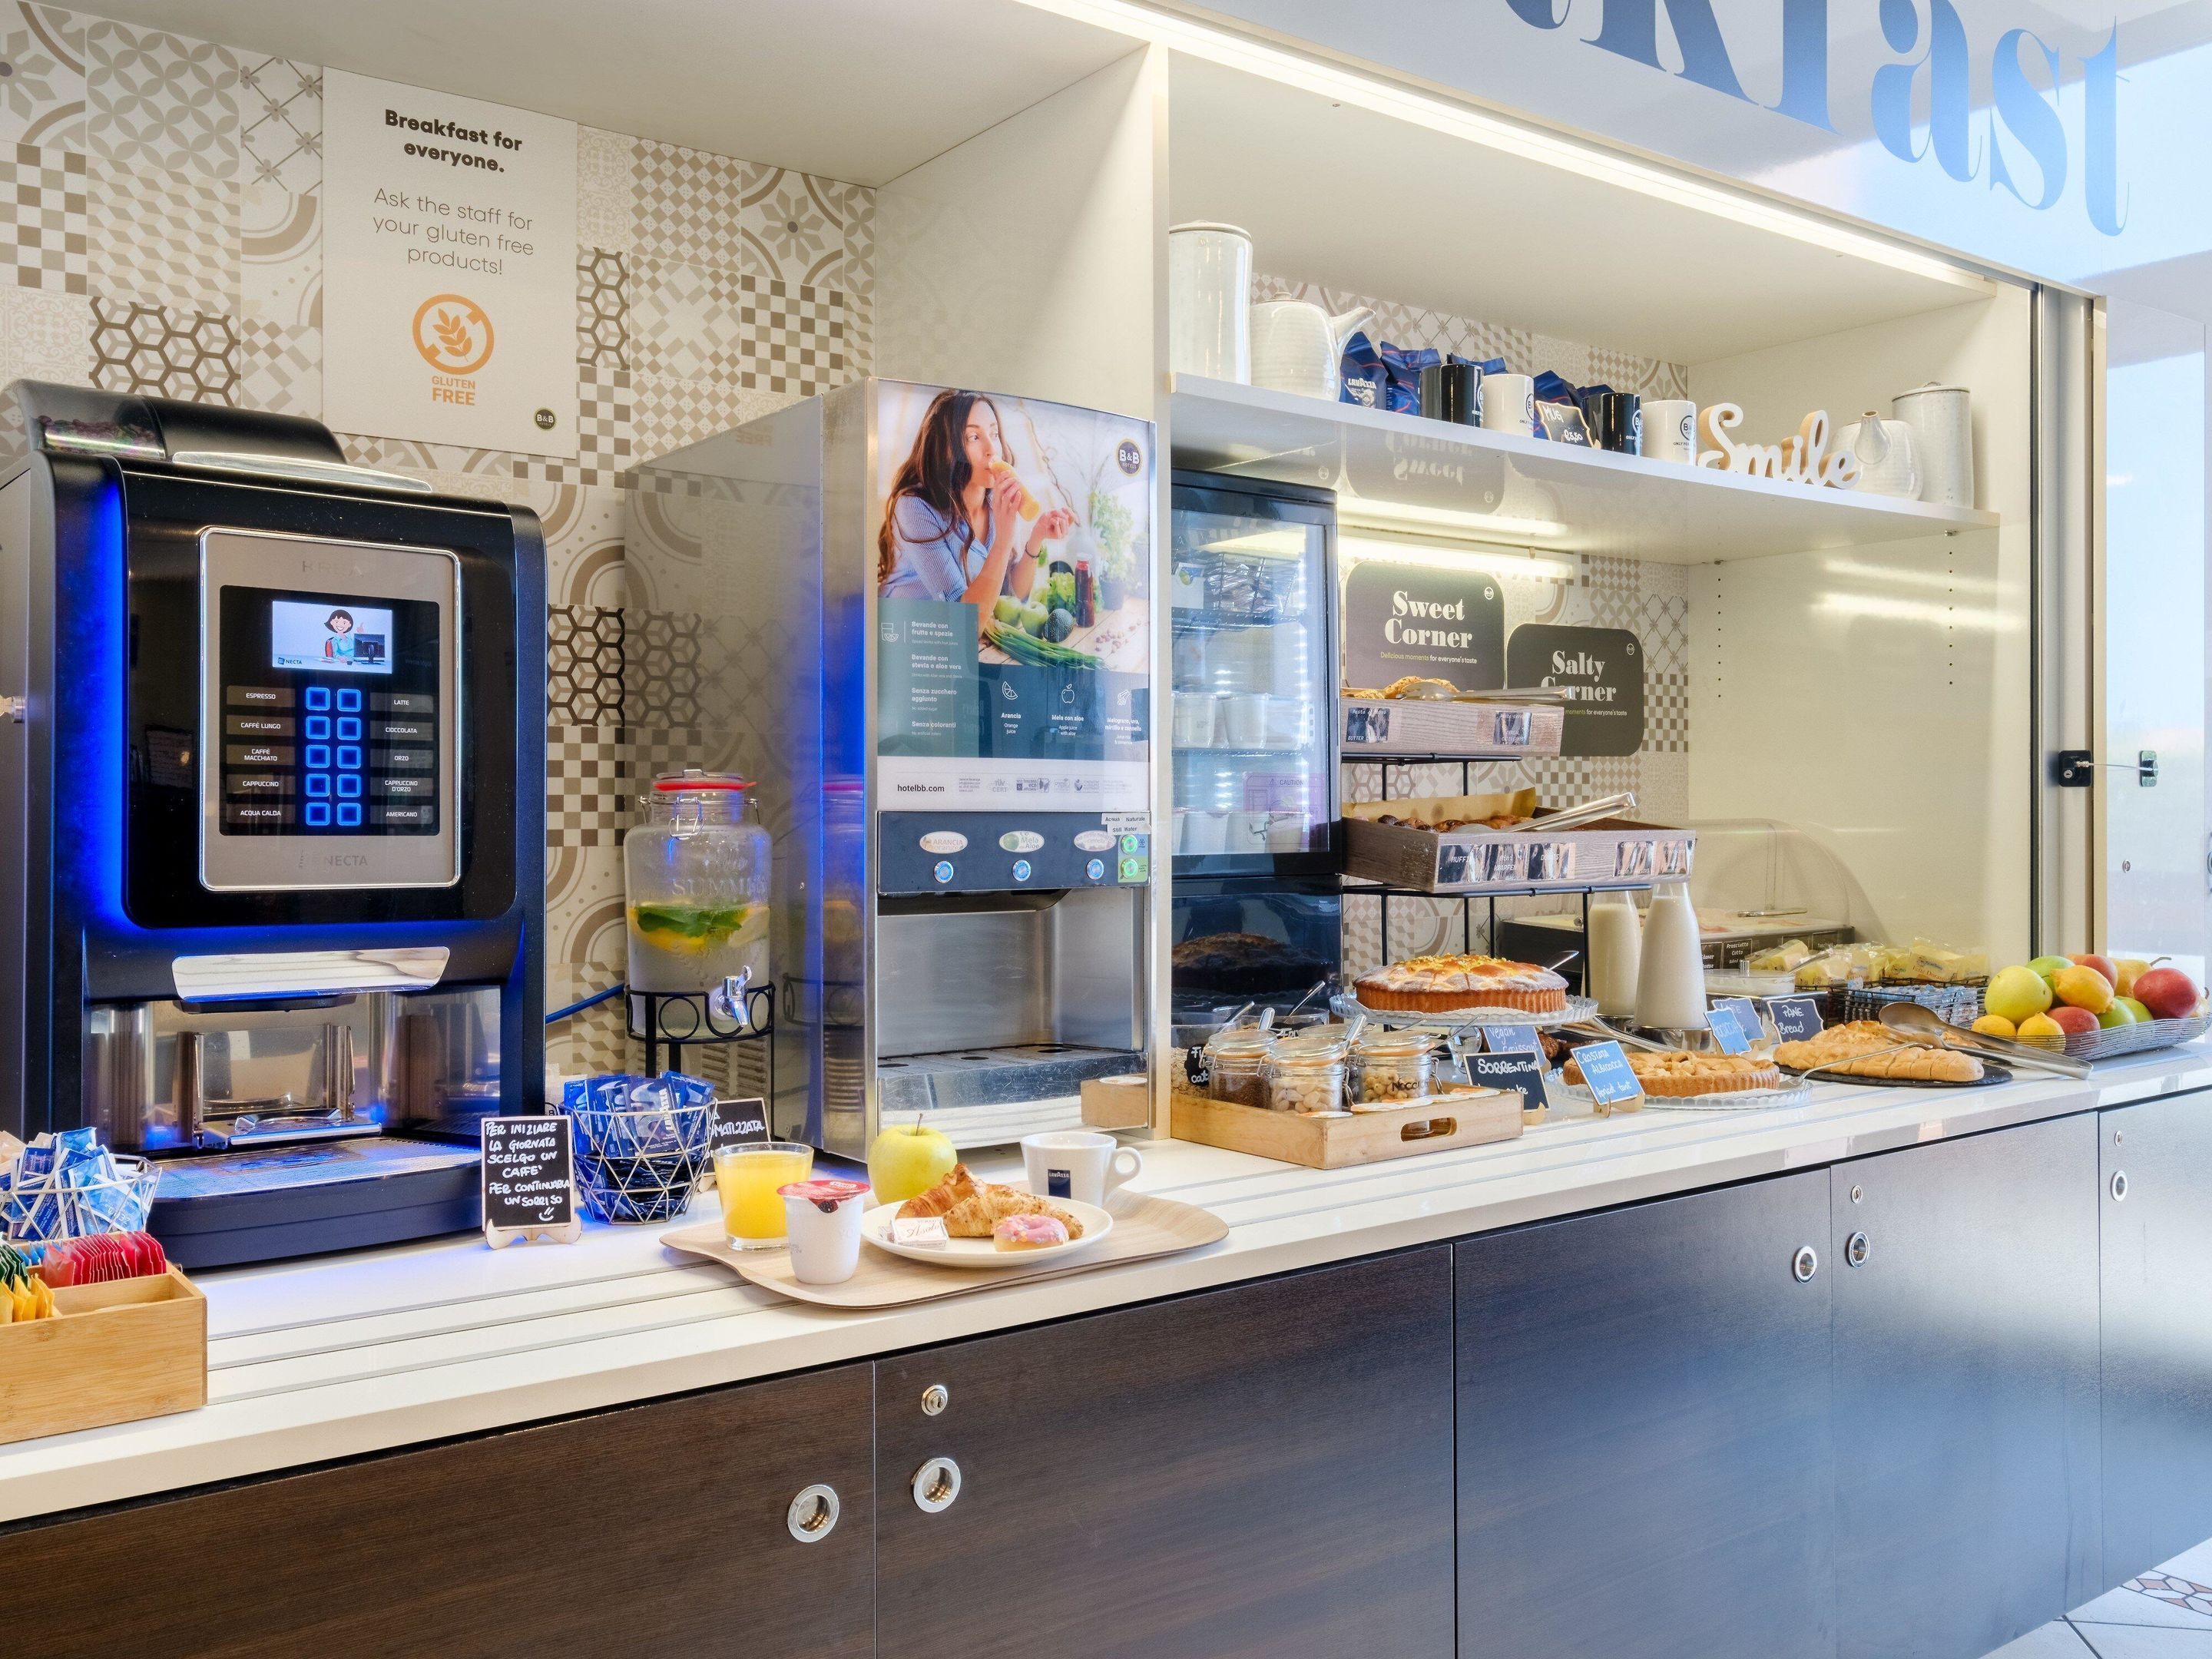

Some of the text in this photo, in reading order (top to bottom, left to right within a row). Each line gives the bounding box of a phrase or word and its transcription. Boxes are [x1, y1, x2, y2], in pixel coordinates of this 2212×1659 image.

[385, 108, 523, 151] Breakfast for
[403, 142, 505, 174] everyone.
[374, 187, 533, 230] Ask the staff for
[373, 217, 534, 255] your gluten free
[408, 248, 502, 275] products!
[431, 376, 476, 390] GLUTEN
[431, 387, 475, 406] FREE
[536, 413, 555, 423] B&B
[1542, 405, 1565, 423] MUG
[1697, 402, 1862, 489] Smile
[1118, 449, 1140, 465] B&B
[1392, 590, 1465, 621] Sweet
[1384, 618, 1473, 649] Corner
[1380, 651, 1404, 660] Delicious
[1551, 650, 1606, 683] Salty
[1540, 676, 1617, 702] Crner
[897, 783, 945, 793] hotelbb.com
[325, 855, 369, 866] NECTA
[1781, 1005, 1804, 1018] PANE
[1488, 1026, 1516, 1045] Vegan
[1777, 1021, 1804, 1035] Bread
[485, 1121, 558, 1137] PER INIZIARE
[488, 1137, 556, 1154] LA GIORNATA
[486, 1151, 558, 1164] SCELGO UN
[488, 1182, 512, 1195] PER
[504, 1195, 564, 1207] UN SORRISO
